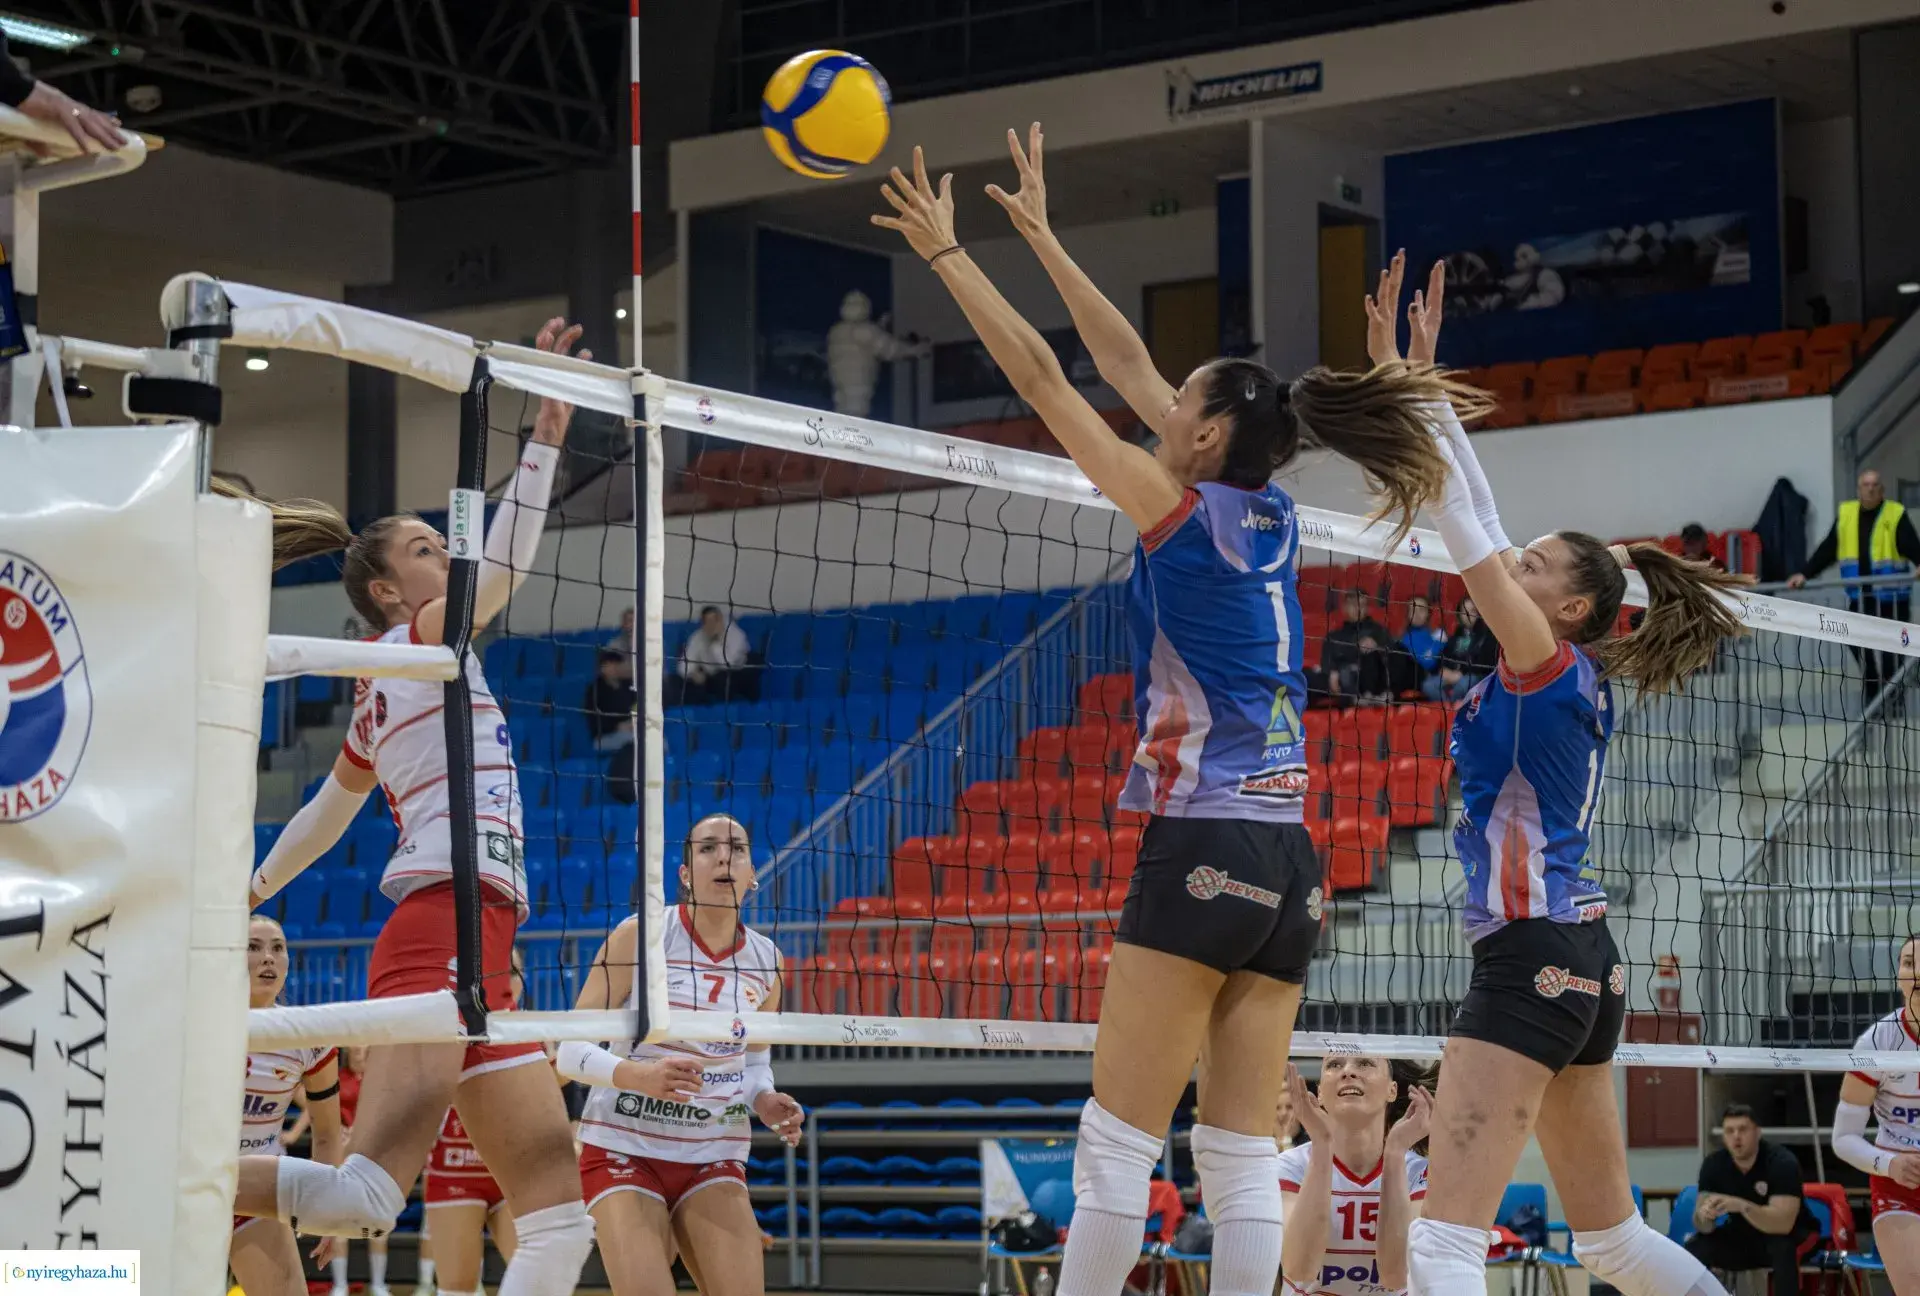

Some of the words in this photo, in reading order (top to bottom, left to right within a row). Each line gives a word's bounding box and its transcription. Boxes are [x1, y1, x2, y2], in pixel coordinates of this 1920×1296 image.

[1200, 67, 1319, 102] MICHELIN
[944, 444, 999, 476] FATUM
[454, 490, 465, 520] rete
[1265, 580, 1291, 673] 1
[1818, 613, 1849, 636] FATUM
[703, 973, 726, 1004] 7
[978, 1024, 1024, 1044] FATUM
[1337, 1201, 1379, 1242] 15
